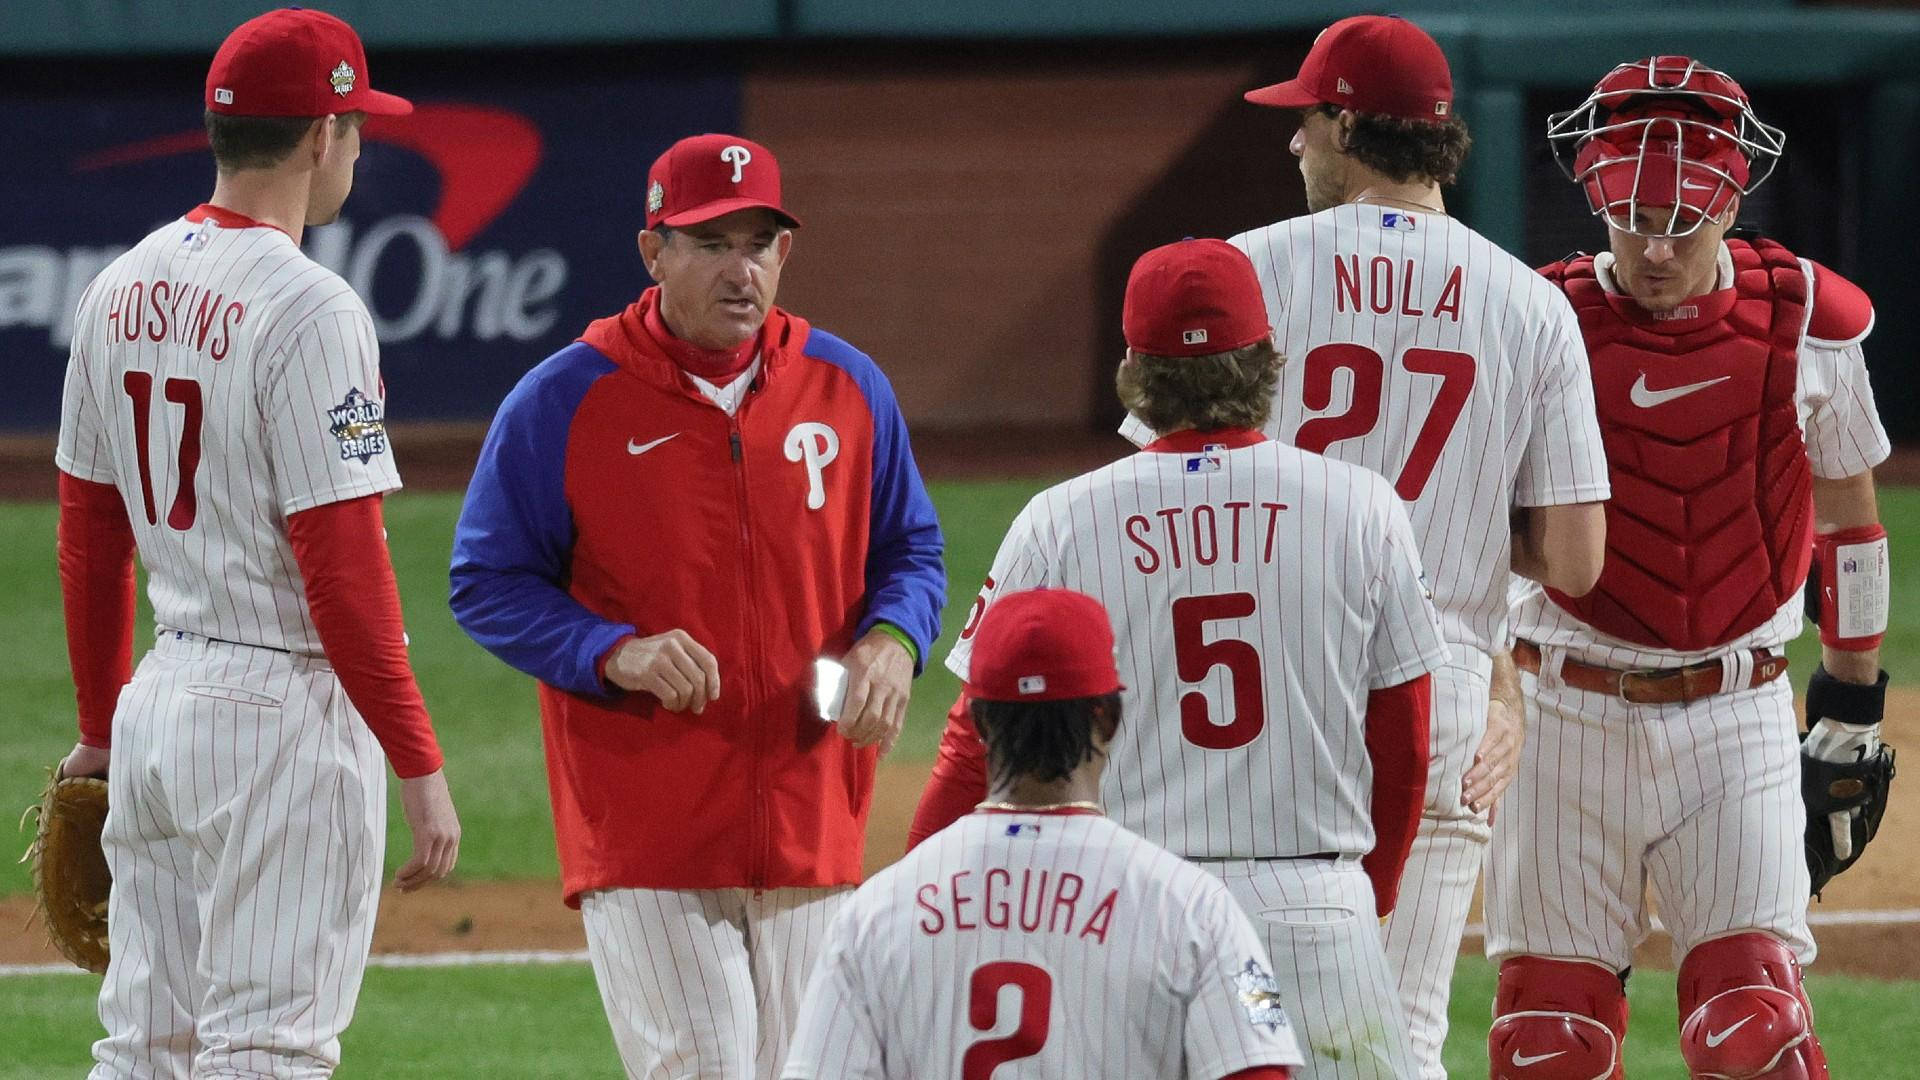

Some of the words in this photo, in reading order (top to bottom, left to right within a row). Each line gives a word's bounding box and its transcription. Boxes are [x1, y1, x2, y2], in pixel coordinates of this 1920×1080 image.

[720, 145, 751, 183] P
[352, 213, 567, 342] One
[1333, 253, 1463, 323] NOLA
[106, 280, 244, 361] HOSKINS
[123, 370, 203, 532] 17
[329, 404, 381, 425] WORLD
[341, 436, 384, 458] SERIES
[1295, 342, 1478, 502] 27
[783, 421, 840, 510] P
[1125, 501, 1289, 575] STOTT
[1171, 591, 1266, 751] 5
[1762, 663, 1776, 680] 10
[916, 867, 1120, 945] SEGURA
[961, 960, 1053, 1080] 2
